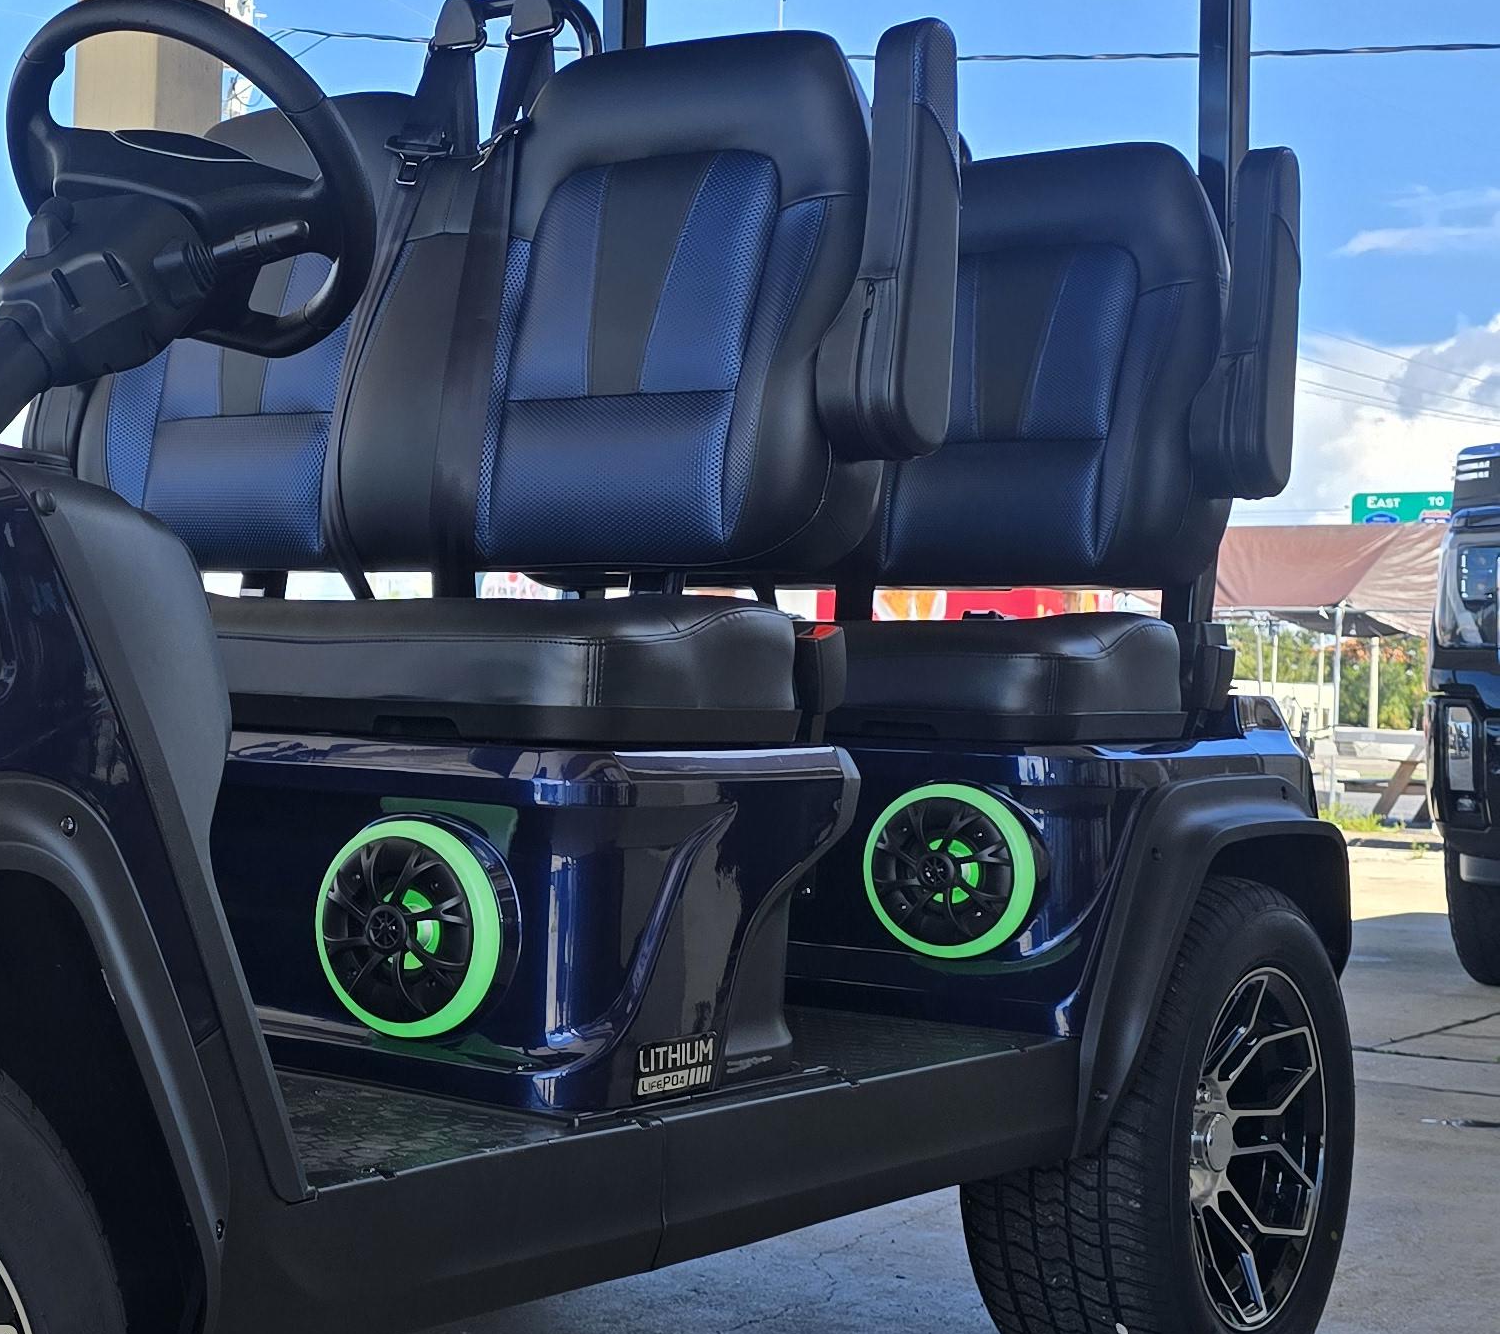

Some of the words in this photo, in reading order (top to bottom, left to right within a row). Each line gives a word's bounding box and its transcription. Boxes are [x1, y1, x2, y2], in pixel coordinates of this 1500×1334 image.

[1366, 496, 1401, 509] EAST
[1428, 496, 1445, 507] TO
[639, 1038, 714, 1073] LITHIUM
